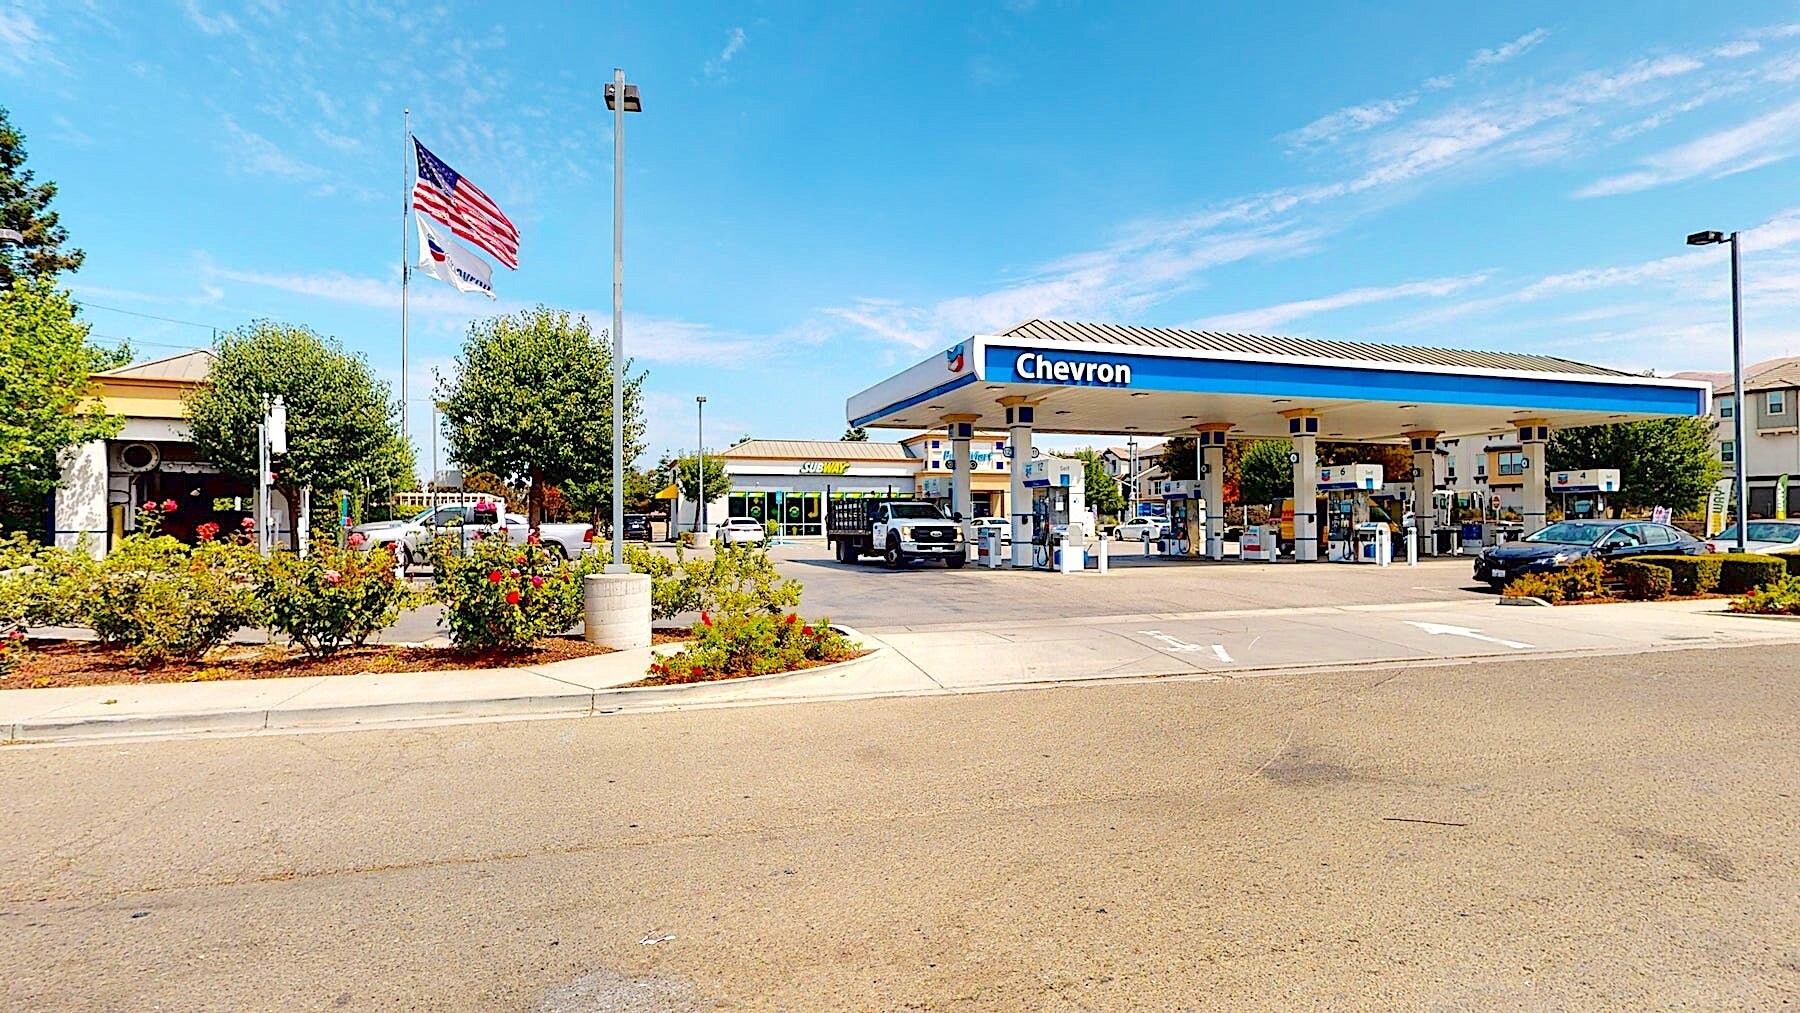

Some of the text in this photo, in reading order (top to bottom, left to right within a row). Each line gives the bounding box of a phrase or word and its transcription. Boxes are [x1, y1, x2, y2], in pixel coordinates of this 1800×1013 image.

[1016, 353, 1131, 383] Chevron
[801, 461, 849, 474] SUBWAY
[1340, 467, 1346, 476] 6
[1580, 471, 1587, 479] 4
